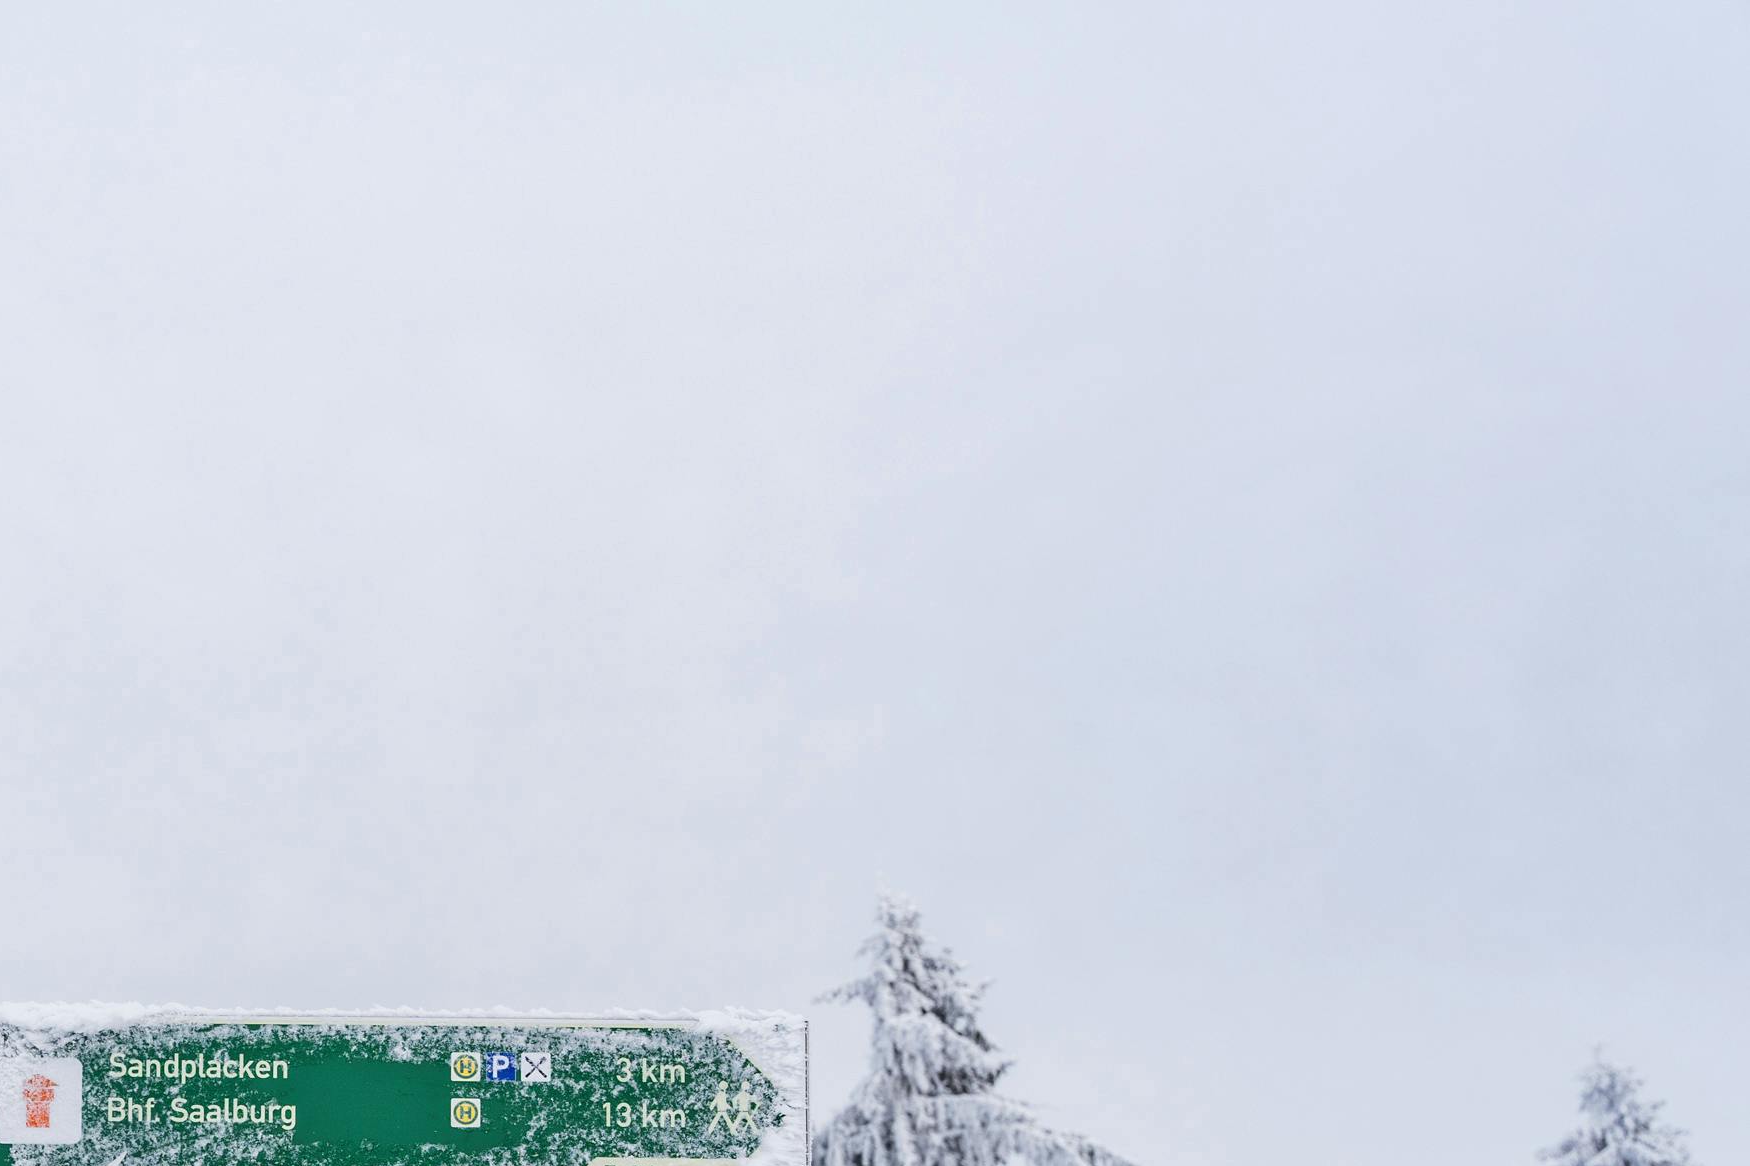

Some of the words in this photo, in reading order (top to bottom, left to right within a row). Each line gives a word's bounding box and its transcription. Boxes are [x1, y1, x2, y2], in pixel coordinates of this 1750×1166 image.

[109, 1053, 289, 1085] Sandplacken
[616, 1057, 632, 1083] 3
[641, 1057, 686, 1083] km
[107, 1098, 160, 1123] Bhf.
[169, 1097, 297, 1130] Saalburg
[601, 1102, 632, 1128] 13
[641, 1101, 687, 1128] km
